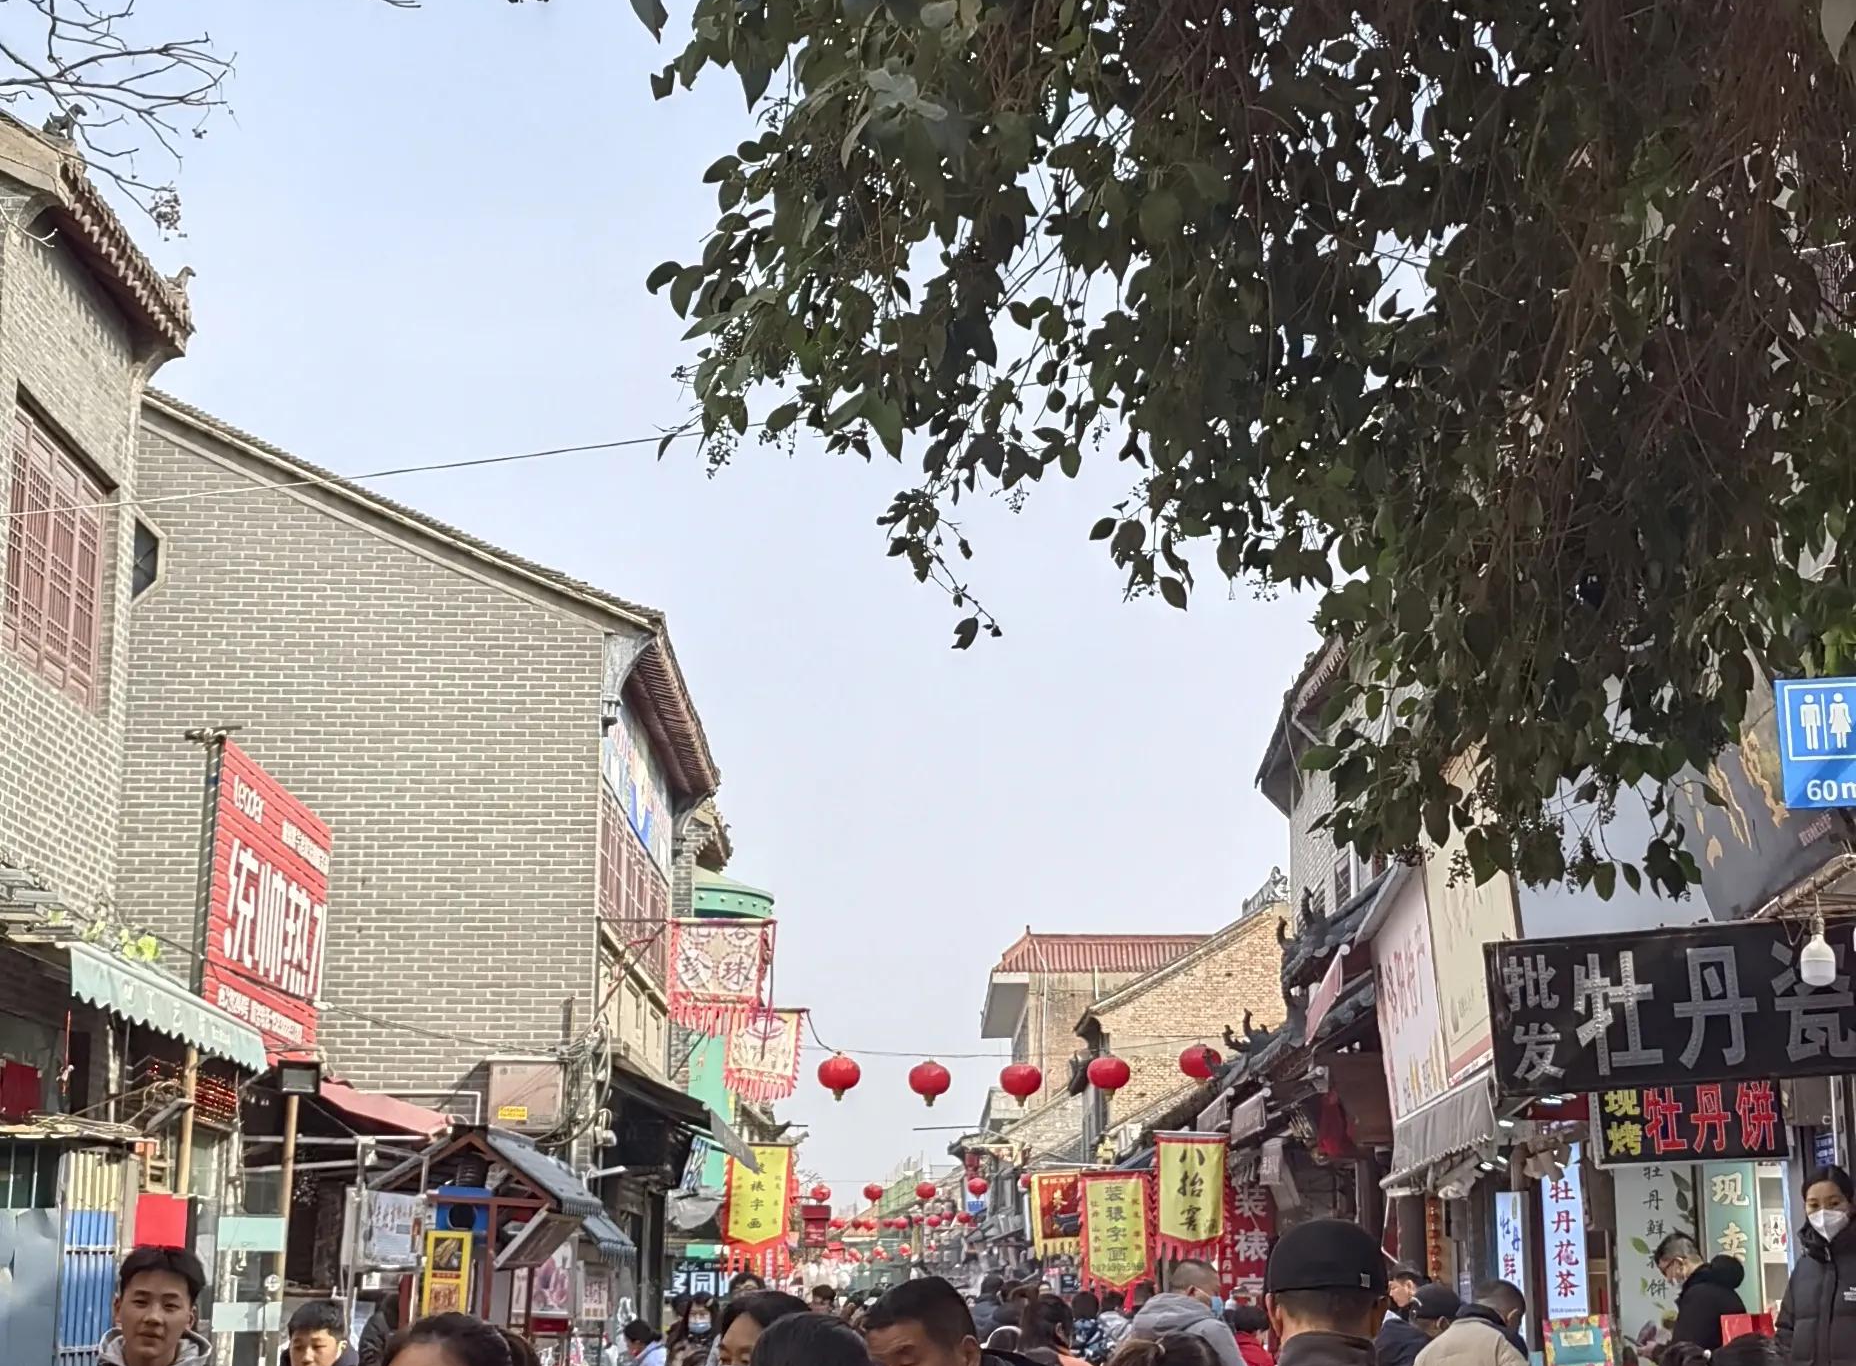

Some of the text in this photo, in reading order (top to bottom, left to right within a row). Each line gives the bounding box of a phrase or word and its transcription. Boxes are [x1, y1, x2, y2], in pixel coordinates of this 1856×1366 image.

[1502, 954, 1565, 1081] 批发
[1604, 1089, 1643, 1156] 现烤
[1643, 1081, 1778, 1155] 牡丹饼
[1550, 1181, 1580, 1298] 牡丹花茶
